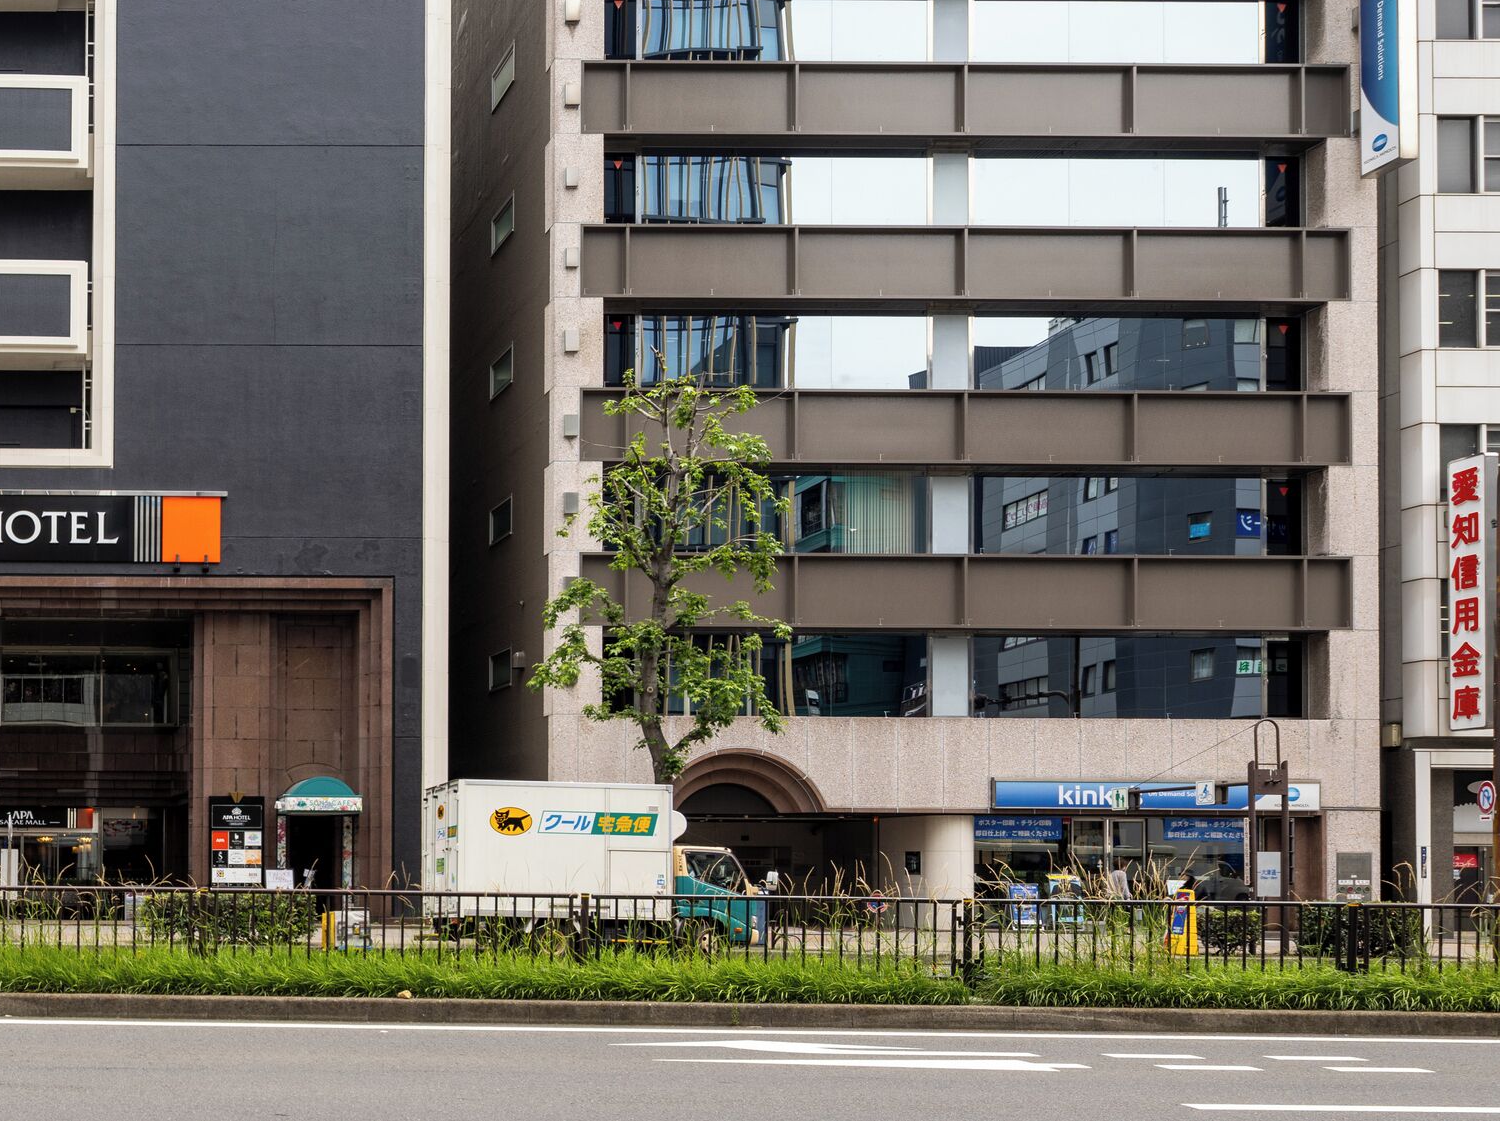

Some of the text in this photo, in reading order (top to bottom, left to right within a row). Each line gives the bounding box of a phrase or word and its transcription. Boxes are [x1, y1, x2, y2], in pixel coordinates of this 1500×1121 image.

[1451, 466, 1481, 721] 愛知信用金庫
[11, 811, 34, 820] APA
[545, 814, 652, 833] クール 宅急便
